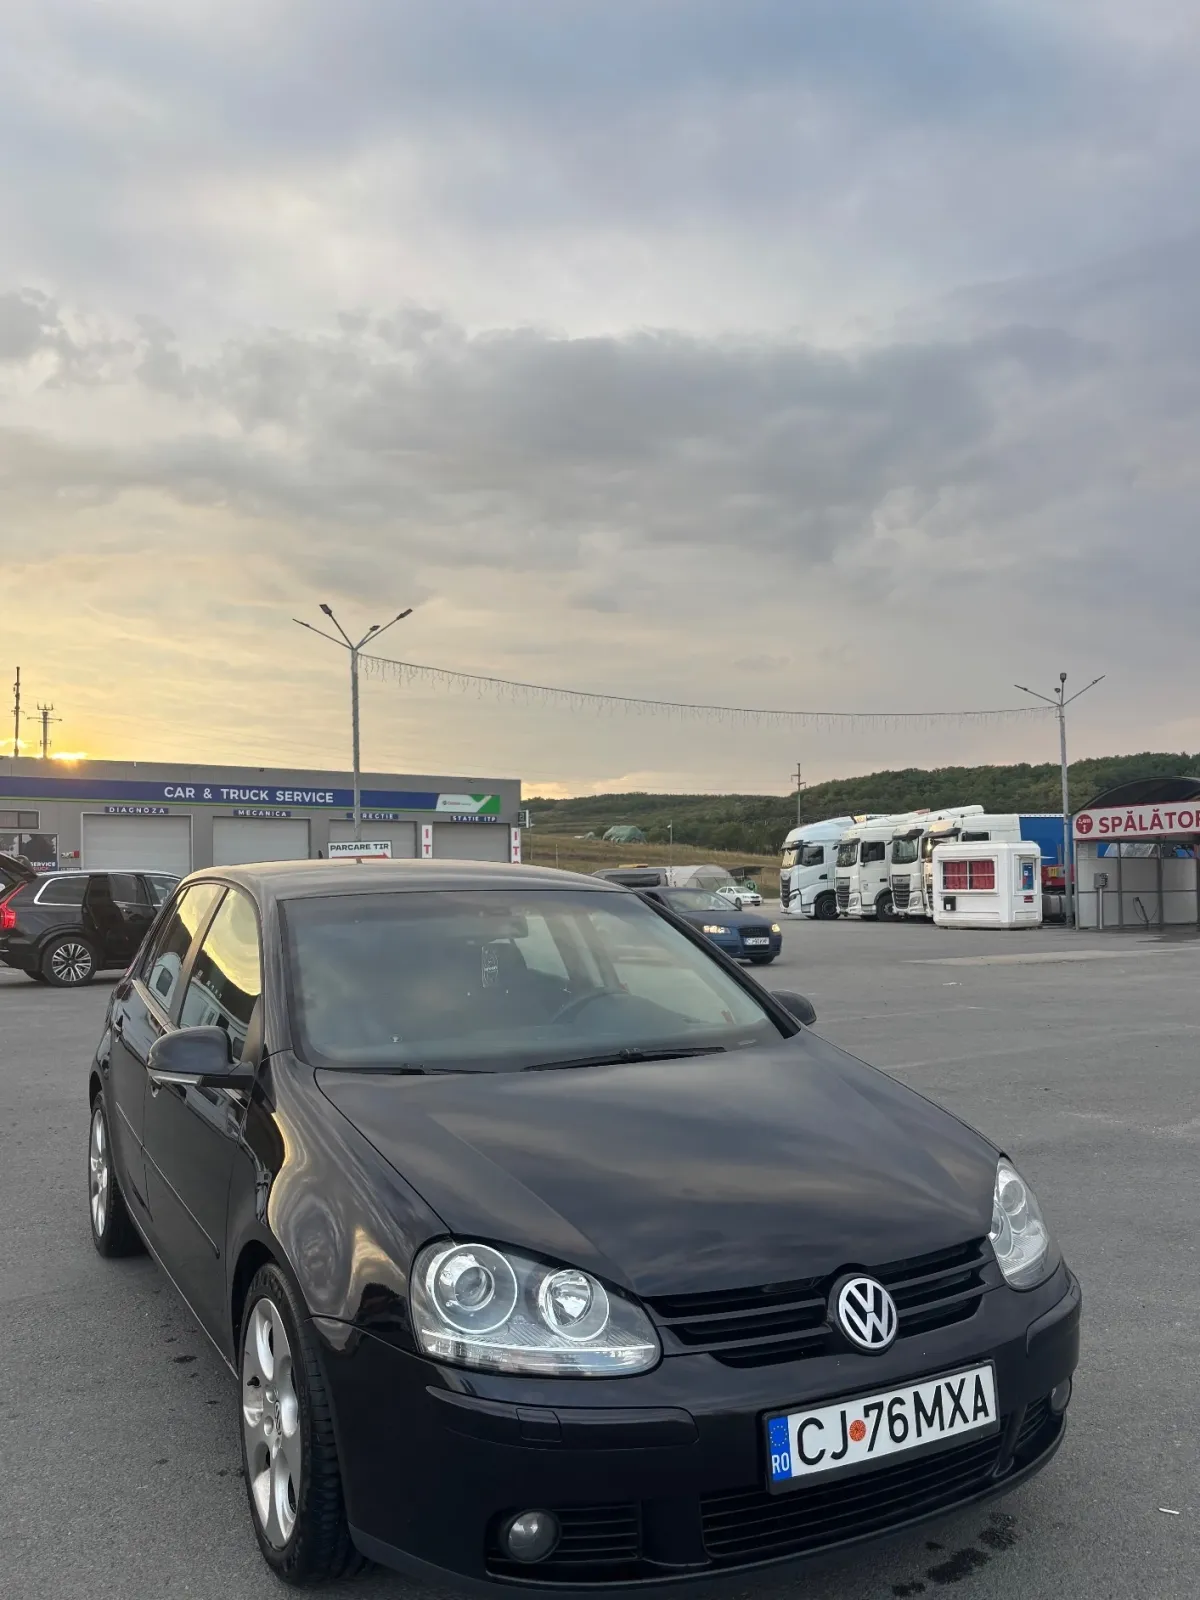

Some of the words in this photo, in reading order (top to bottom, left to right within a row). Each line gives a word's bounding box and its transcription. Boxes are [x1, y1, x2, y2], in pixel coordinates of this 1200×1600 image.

[164, 786, 195, 799] CAR
[203, 787, 212, 799] &
[221, 788, 269, 801] TRUCK
[276, 790, 334, 803] SERVICE
[109, 806, 166, 814] DIAGNOZA
[238, 809, 287, 817] MECANICA
[330, 843, 371, 851] PARCARE
[512, 831, 520, 864] IT
[772, 1453, 790, 1475] RO
